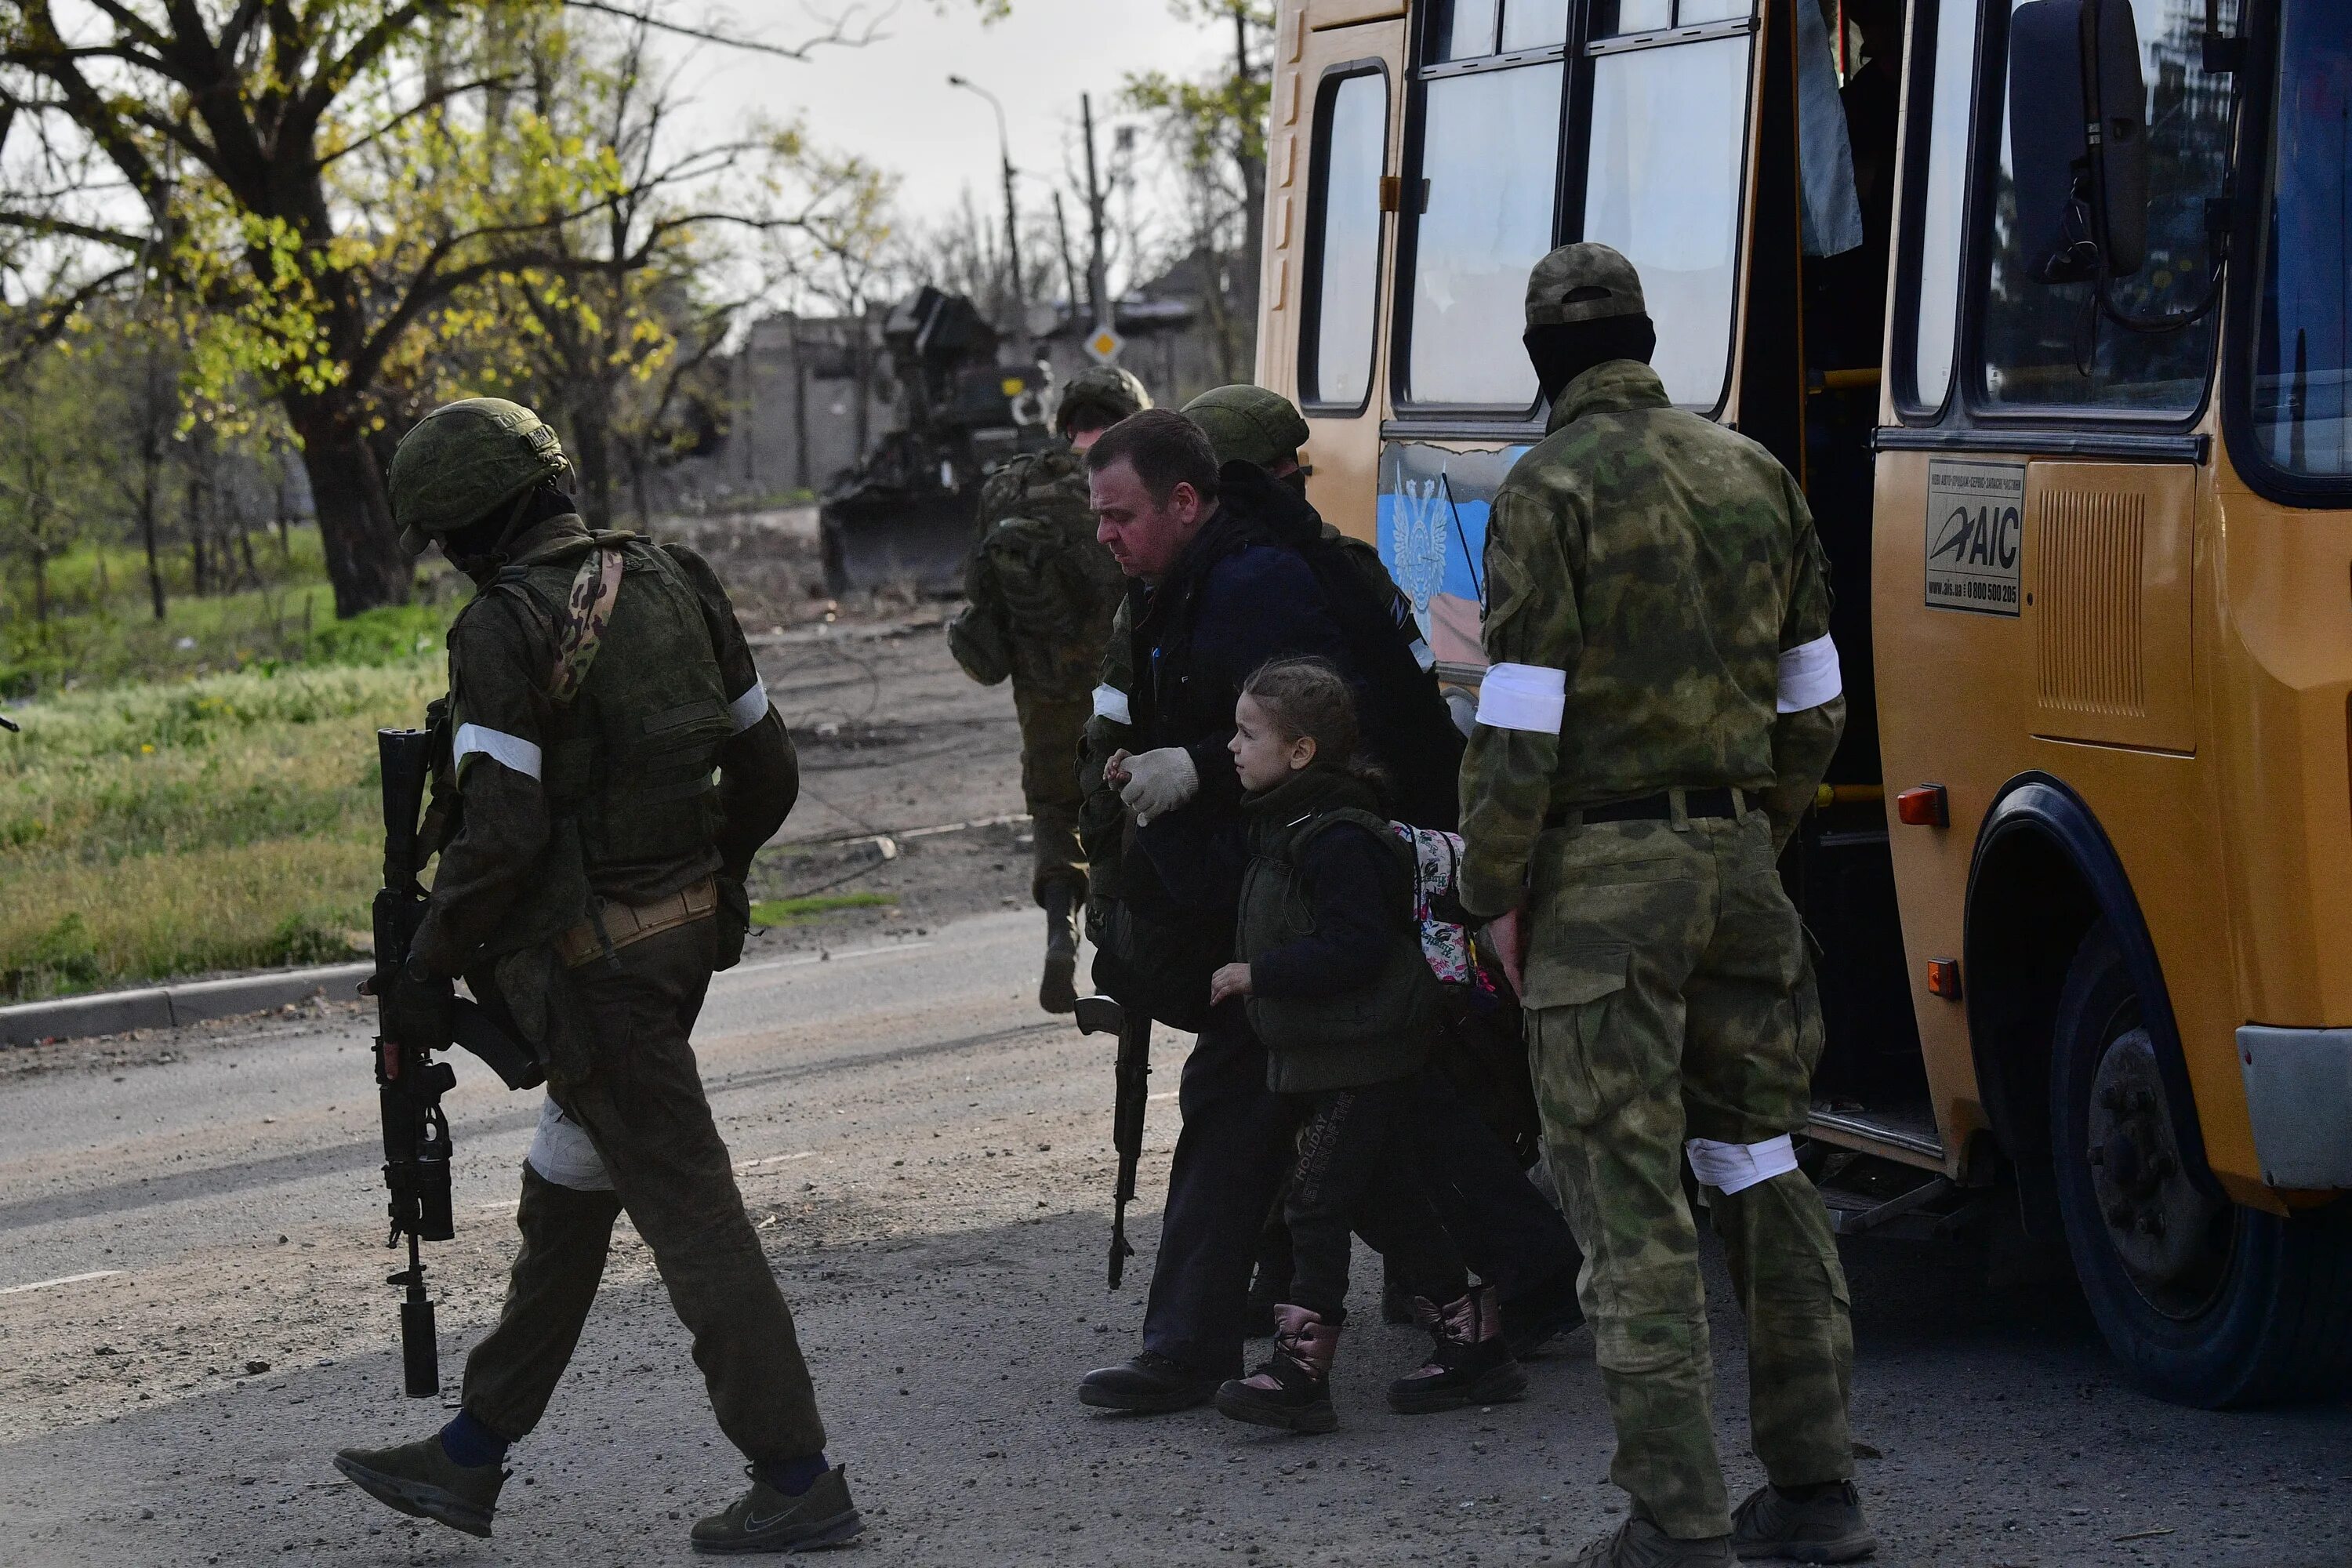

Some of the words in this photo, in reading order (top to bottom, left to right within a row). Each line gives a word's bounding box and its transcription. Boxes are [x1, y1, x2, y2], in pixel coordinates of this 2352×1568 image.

[1928, 579, 1962, 597] www.ais.ua
[1967, 581, 1972, 598] 0
[1973, 582, 1987, 600] 800
[1987, 583, 2002, 601] 500
[2002, 585, 2016, 604] 205
[1331, 1091, 1356, 1122] THE
[1296, 1113, 1327, 1181] HOLIDAY
[1323, 1122, 1340, 1146] OF
